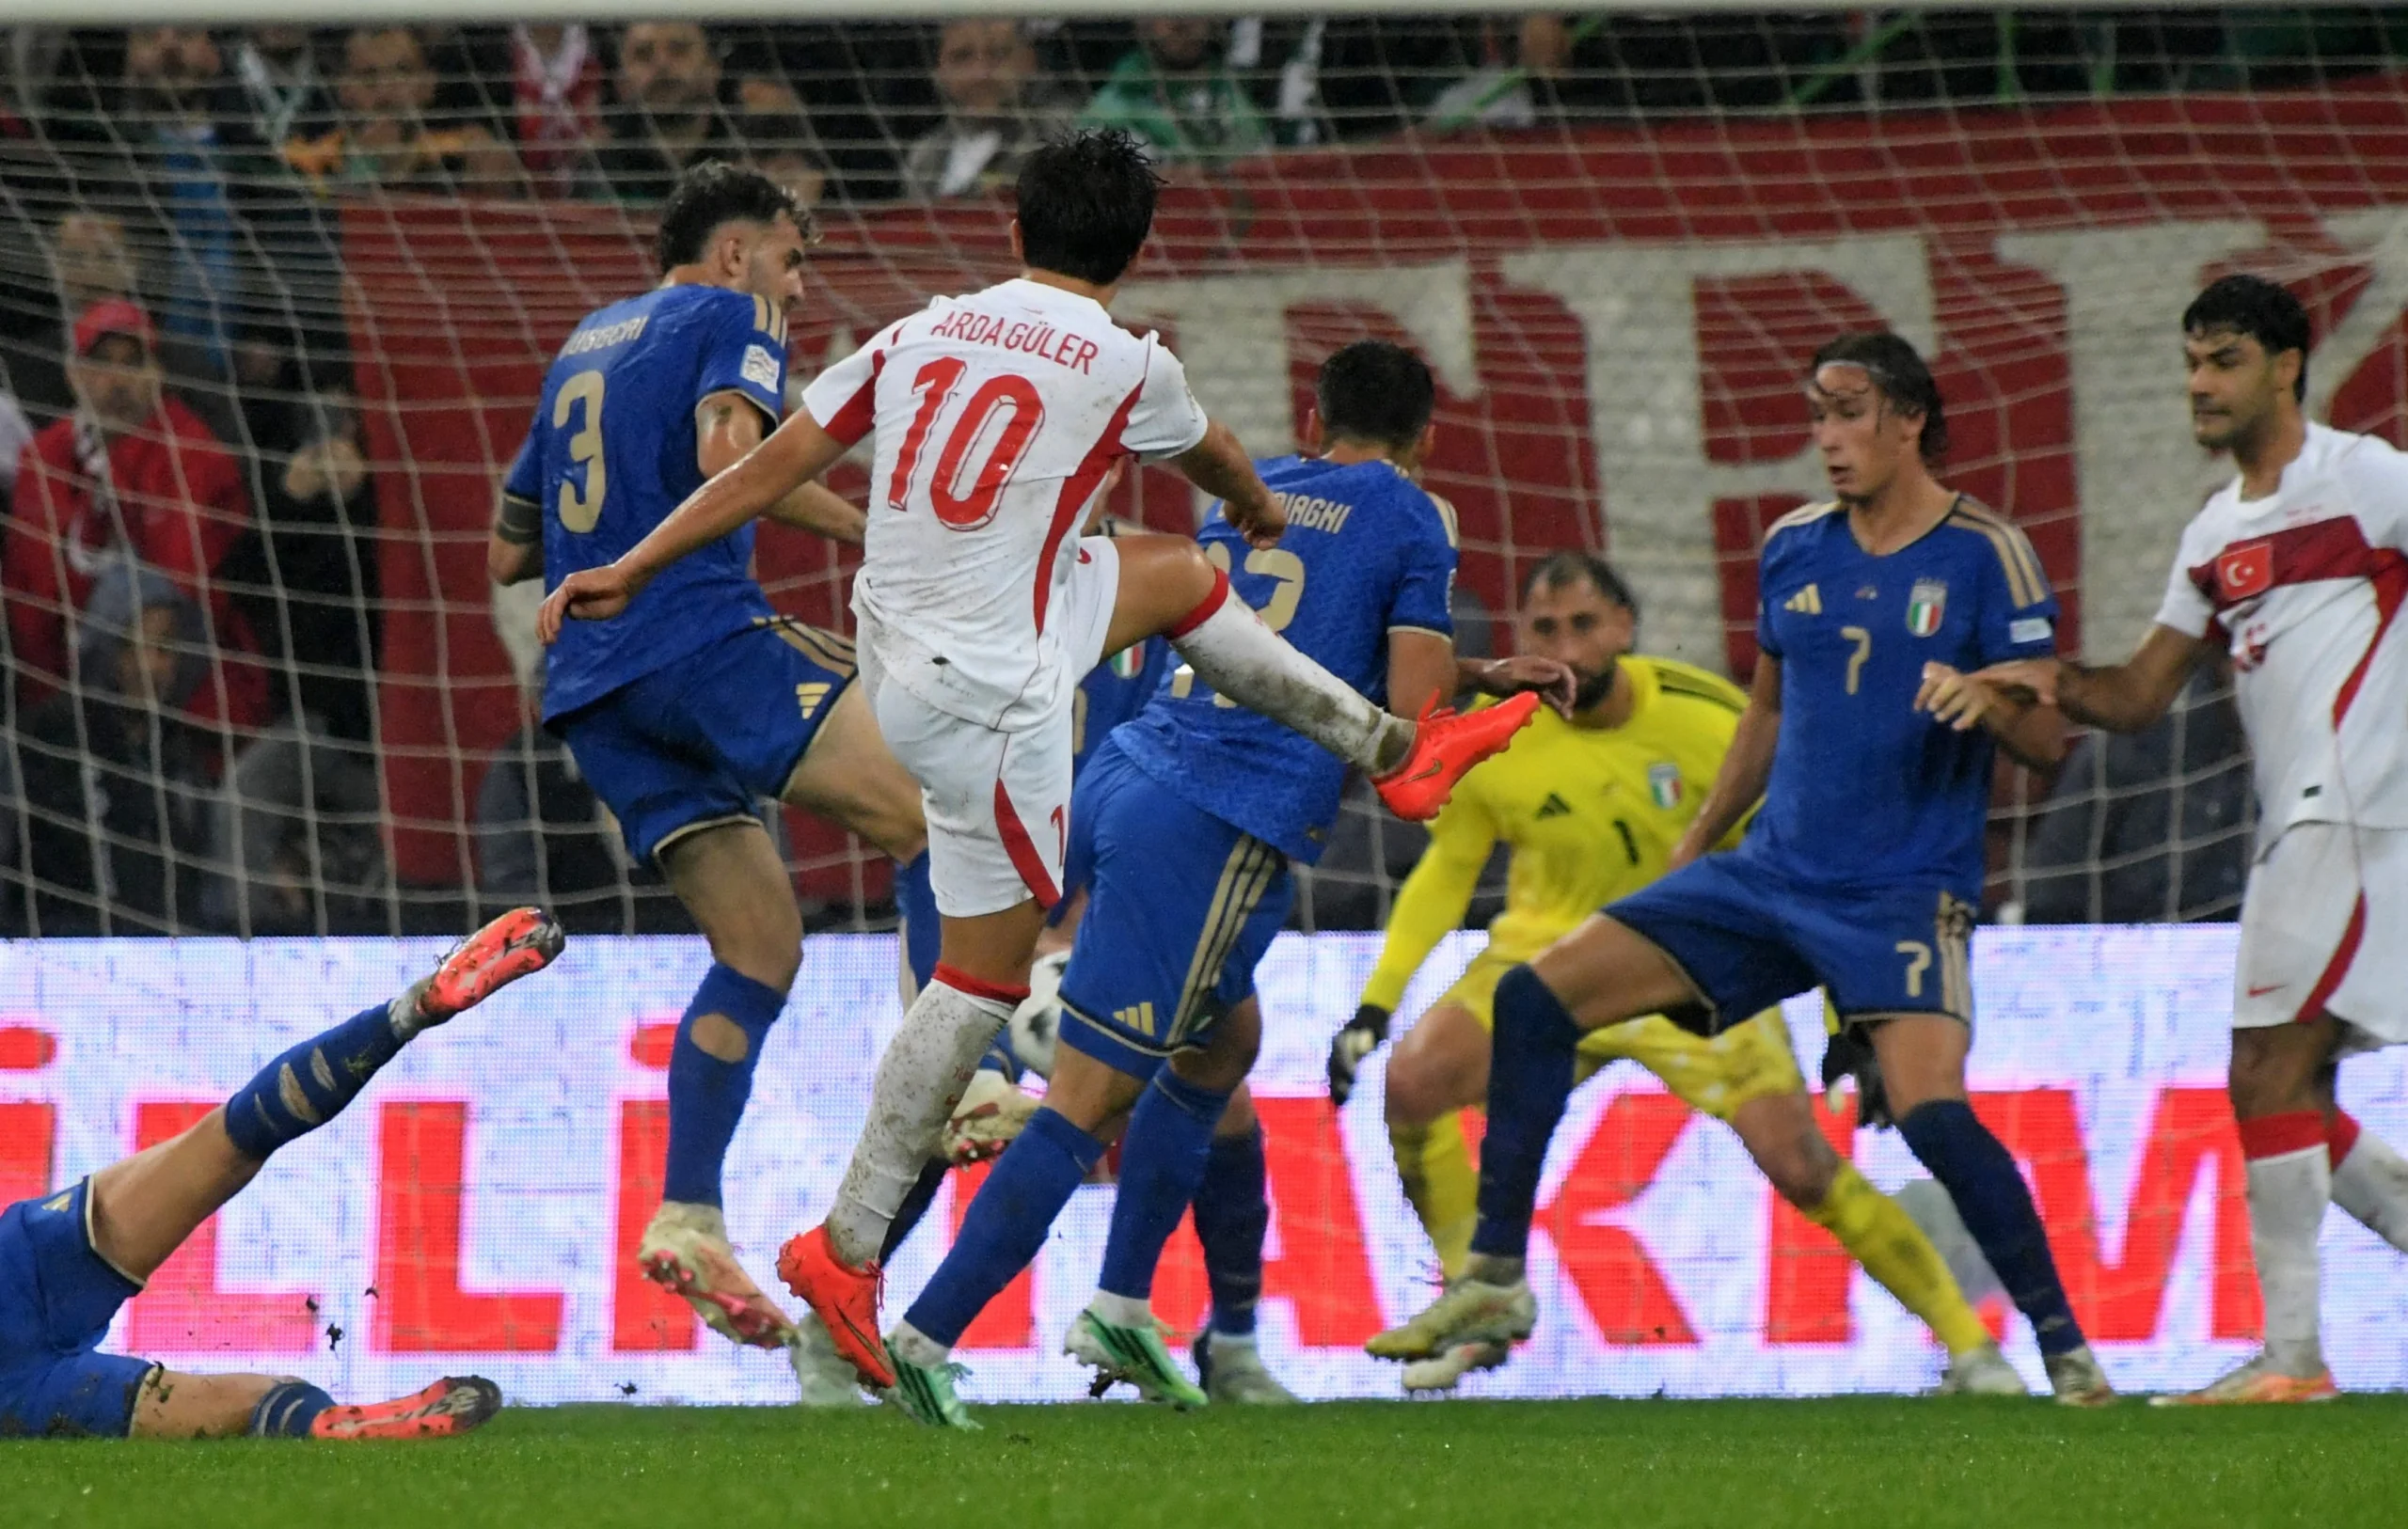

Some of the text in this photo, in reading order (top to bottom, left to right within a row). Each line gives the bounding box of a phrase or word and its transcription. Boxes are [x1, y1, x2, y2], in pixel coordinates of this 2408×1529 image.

[930, 310, 1100, 375] ARDA GÜLER
[553, 370, 606, 534] 3
[888, 356, 1046, 531] 10
[1841, 626, 1871, 695] 7
[1613, 820, 1640, 866] 1
[1895, 941, 1932, 998] 7
